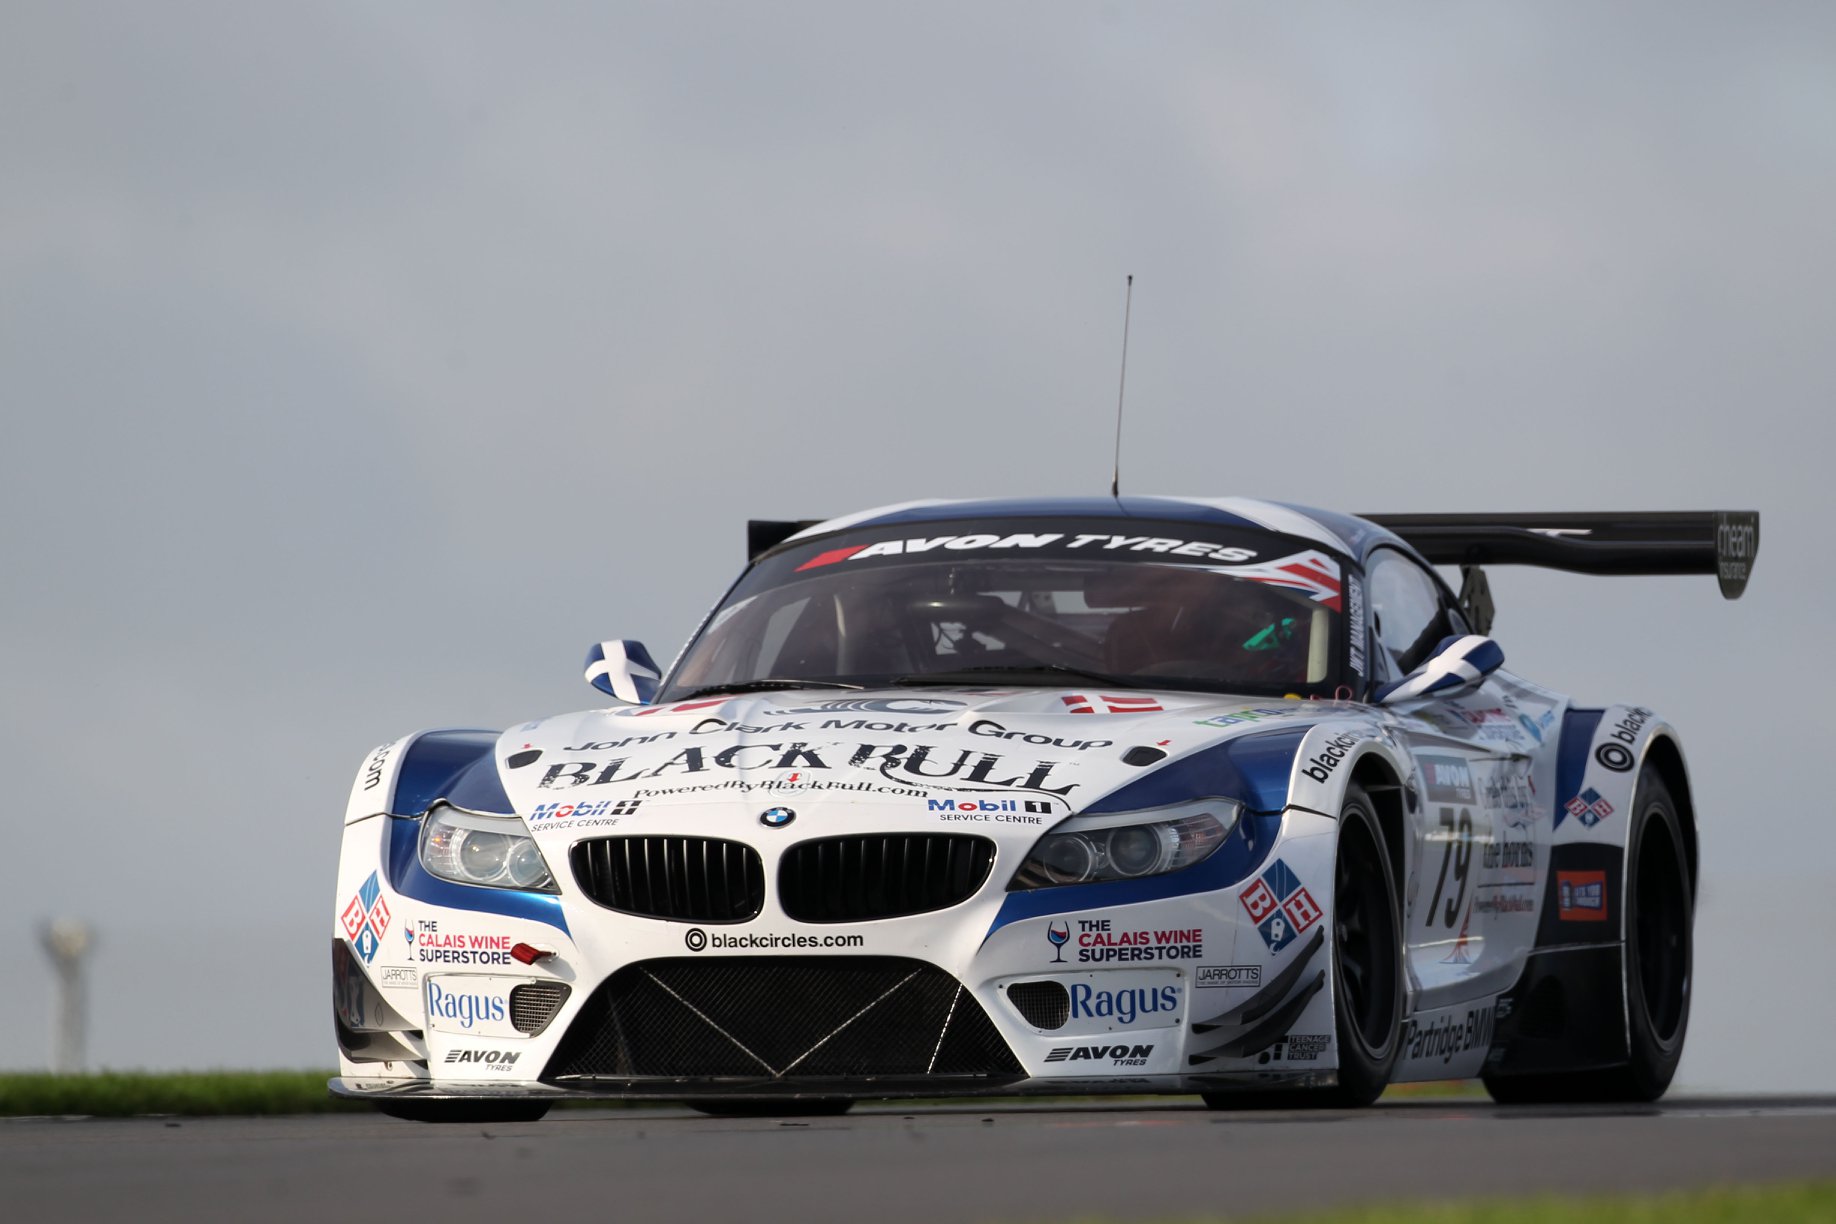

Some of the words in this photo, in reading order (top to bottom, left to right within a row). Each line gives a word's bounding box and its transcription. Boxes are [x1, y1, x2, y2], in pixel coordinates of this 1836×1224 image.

[847, 533, 1063, 561] AVON
[1062, 533, 1258, 564] TYRES
[563, 731, 677, 751] John
[689, 718, 813, 735] Clark
[820, 718, 958, 733] Motor
[968, 719, 1114, 751] Group
[536, 742, 833, 790] BLACK
[529, 801, 612, 821] Mobil
[927, 798, 1017, 812] Mobil
[531, 819, 575, 832] SERVICE
[576, 818, 620, 828] CENTRE
[939, 814, 991, 822] SERVICE
[995, 814, 1042, 825] CENTRE
[1425, 807, 1473, 929] 79
[1244, 882, 1273, 919] B
[1285, 891, 1321, 928] H
[418, 920, 437, 933] THE
[1078, 919, 1111, 932] THE
[418, 934, 466, 949] CALAIS
[469, 935, 511, 950] WINE
[711, 933, 864, 948] blackcircles.com
[1078, 932, 1150, 947] CALAIS
[1153, 929, 1203, 945] WINE
[419, 949, 511, 965] SUPERSTORE
[1078, 944, 1203, 963] SUPERSTORE
[383, 969, 417, 981] JARROTTS
[1198, 967, 1259, 981] JARROTTS
[428, 980, 505, 1028] Ragus
[1070, 983, 1178, 1024] Ragus
[1291, 1035, 1329, 1043] TEENAGE
[1403, 1015, 1464, 1065] Partridge
[457, 1050, 521, 1064] AVON
[1069, 1044, 1154, 1060] AVON
[1288, 1052, 1316, 1060] TRUST
[485, 1064, 513, 1072] TYRES
[1112, 1058, 1147, 1066] TYRES
